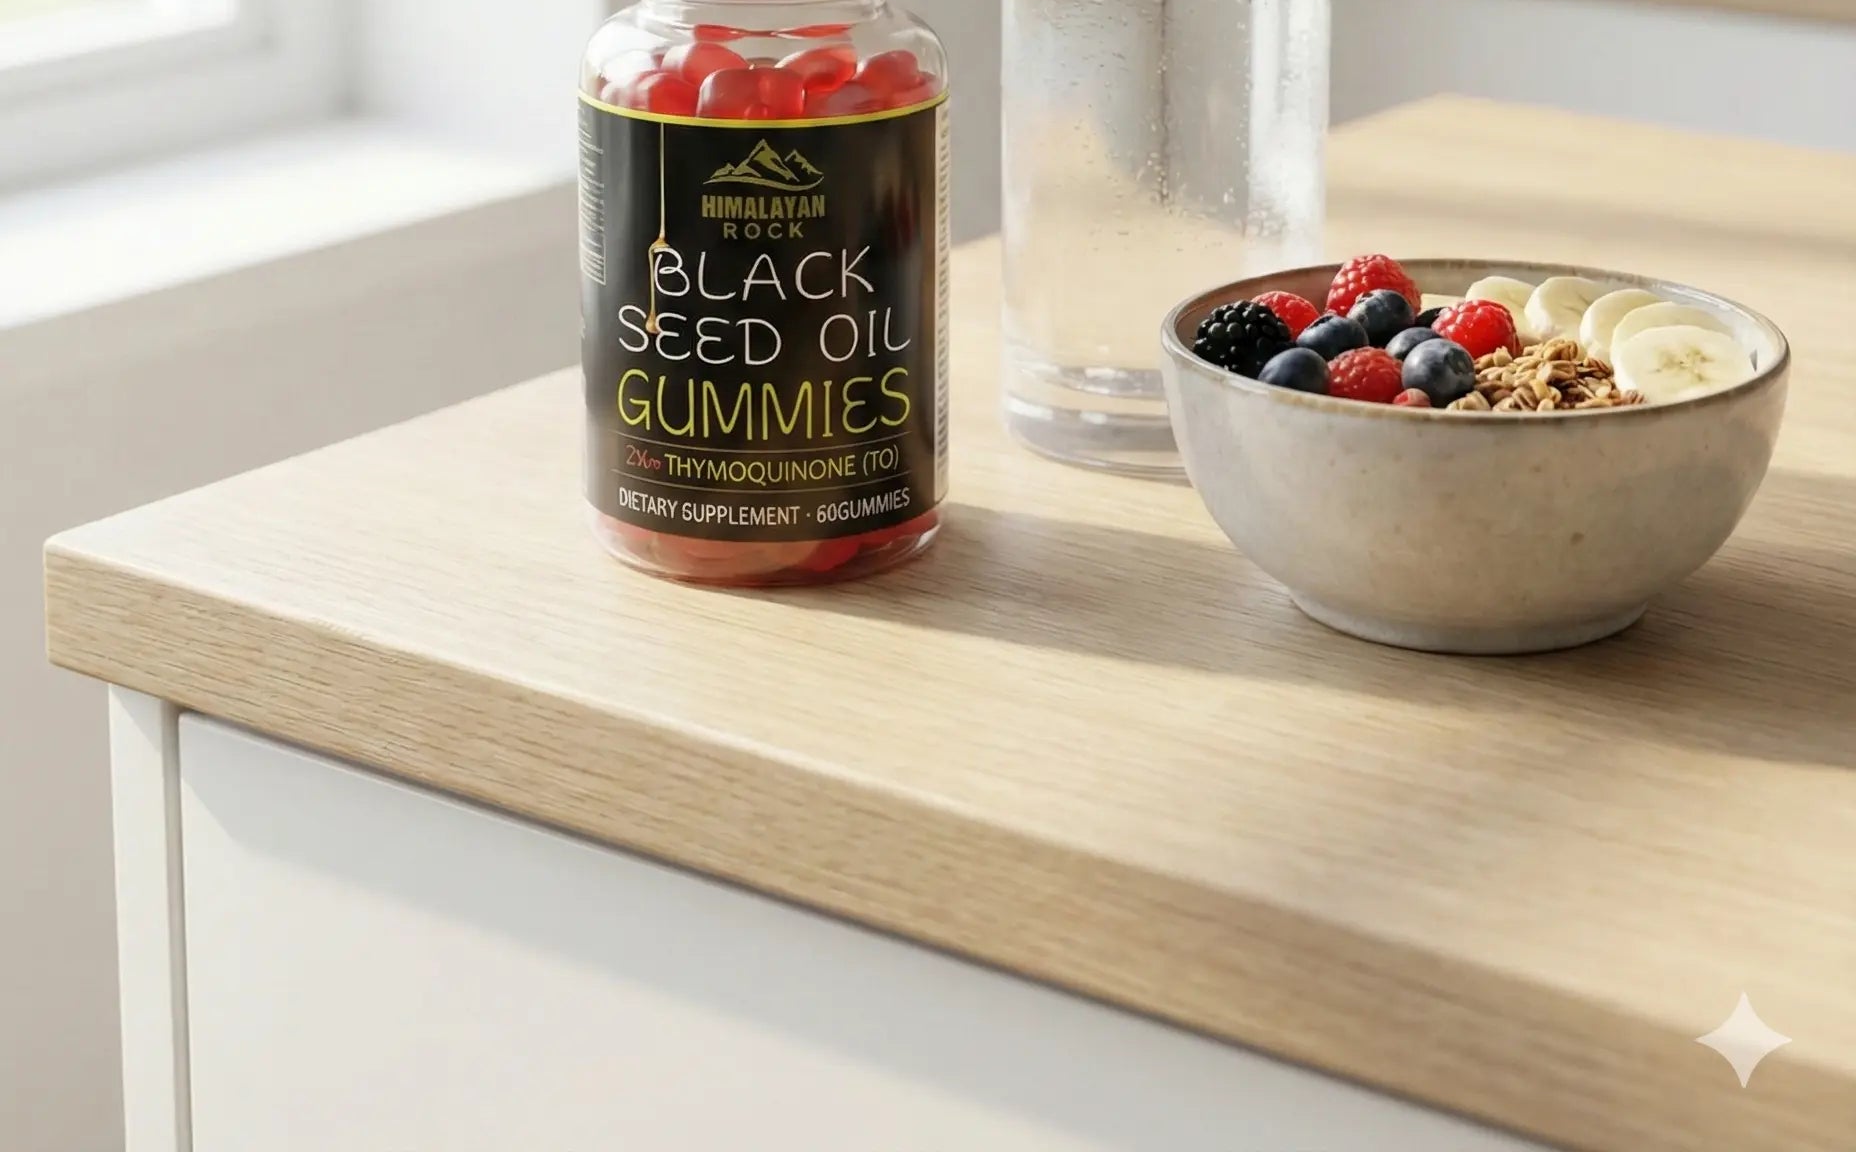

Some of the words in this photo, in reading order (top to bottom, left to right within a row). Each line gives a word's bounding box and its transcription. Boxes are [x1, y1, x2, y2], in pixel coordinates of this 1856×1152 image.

[701, 195, 825, 219] HIMALAYAN
[723, 221, 804, 240] ROCK
[651, 245, 875, 301] BLACK
[618, 305, 782, 365] SEED
[819, 307, 911, 362] OIL
[616, 367, 911, 440] GUMMIES
[664, 453, 857, 486] THYMOQUINONE
[619, 486, 678, 519] DIETARY
[682, 502, 800, 526] SUPPLEMENT
